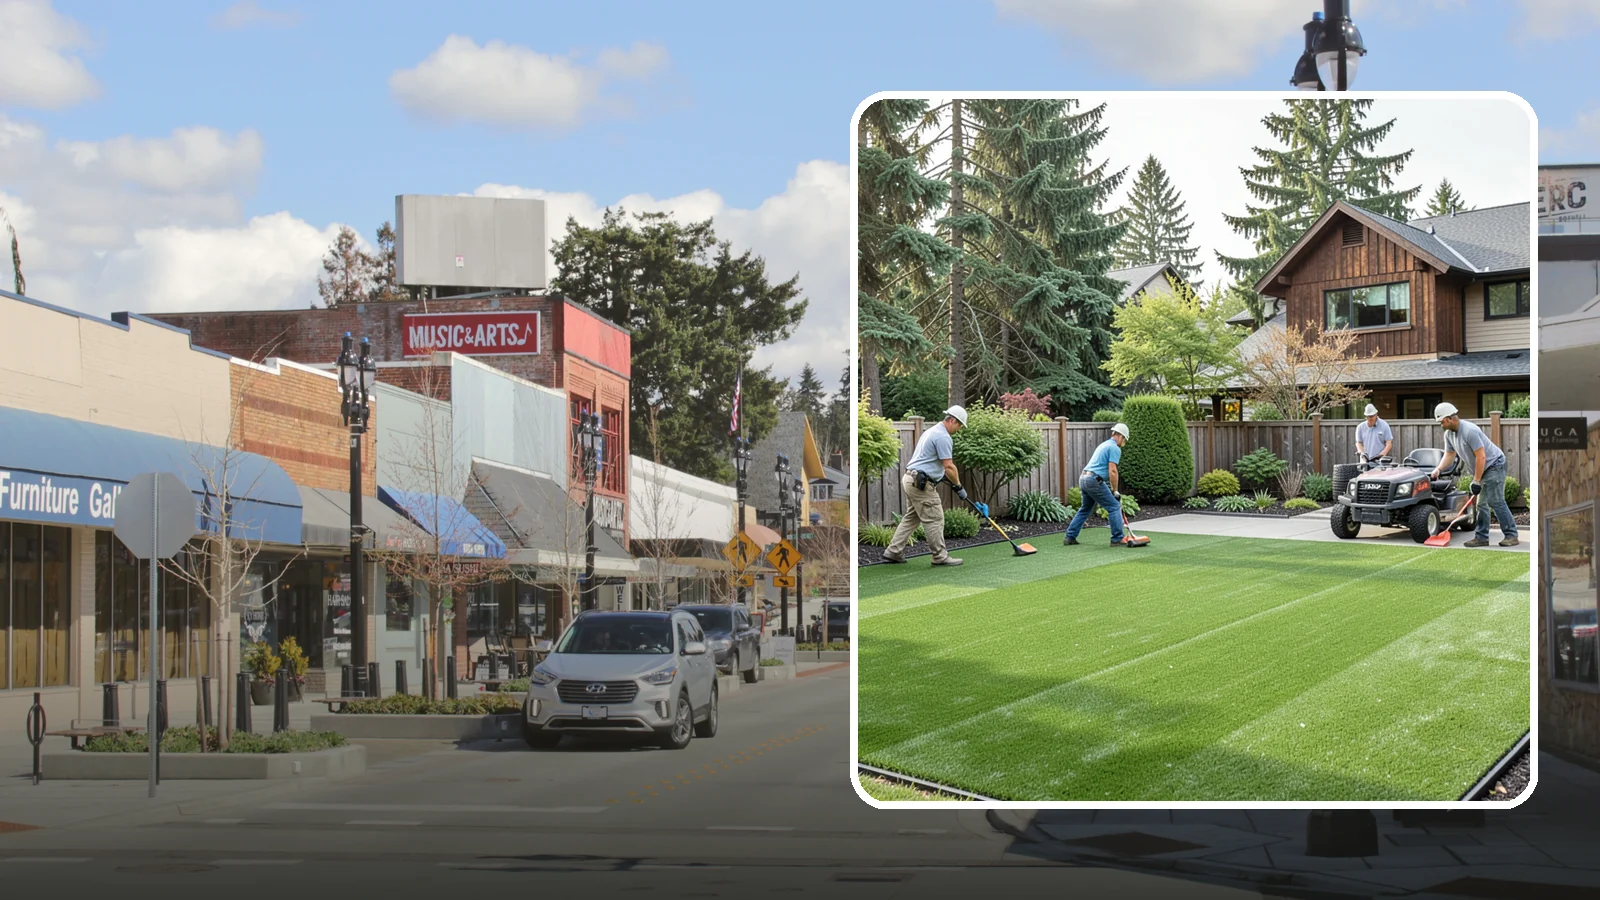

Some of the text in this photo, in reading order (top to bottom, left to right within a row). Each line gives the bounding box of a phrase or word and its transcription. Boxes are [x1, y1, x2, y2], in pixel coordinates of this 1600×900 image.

[409, 323, 519, 349] MUSIC&ARTS
[1541, 427, 1577, 436] UGA
[0, 471, 122, 519] Furniture Gal
